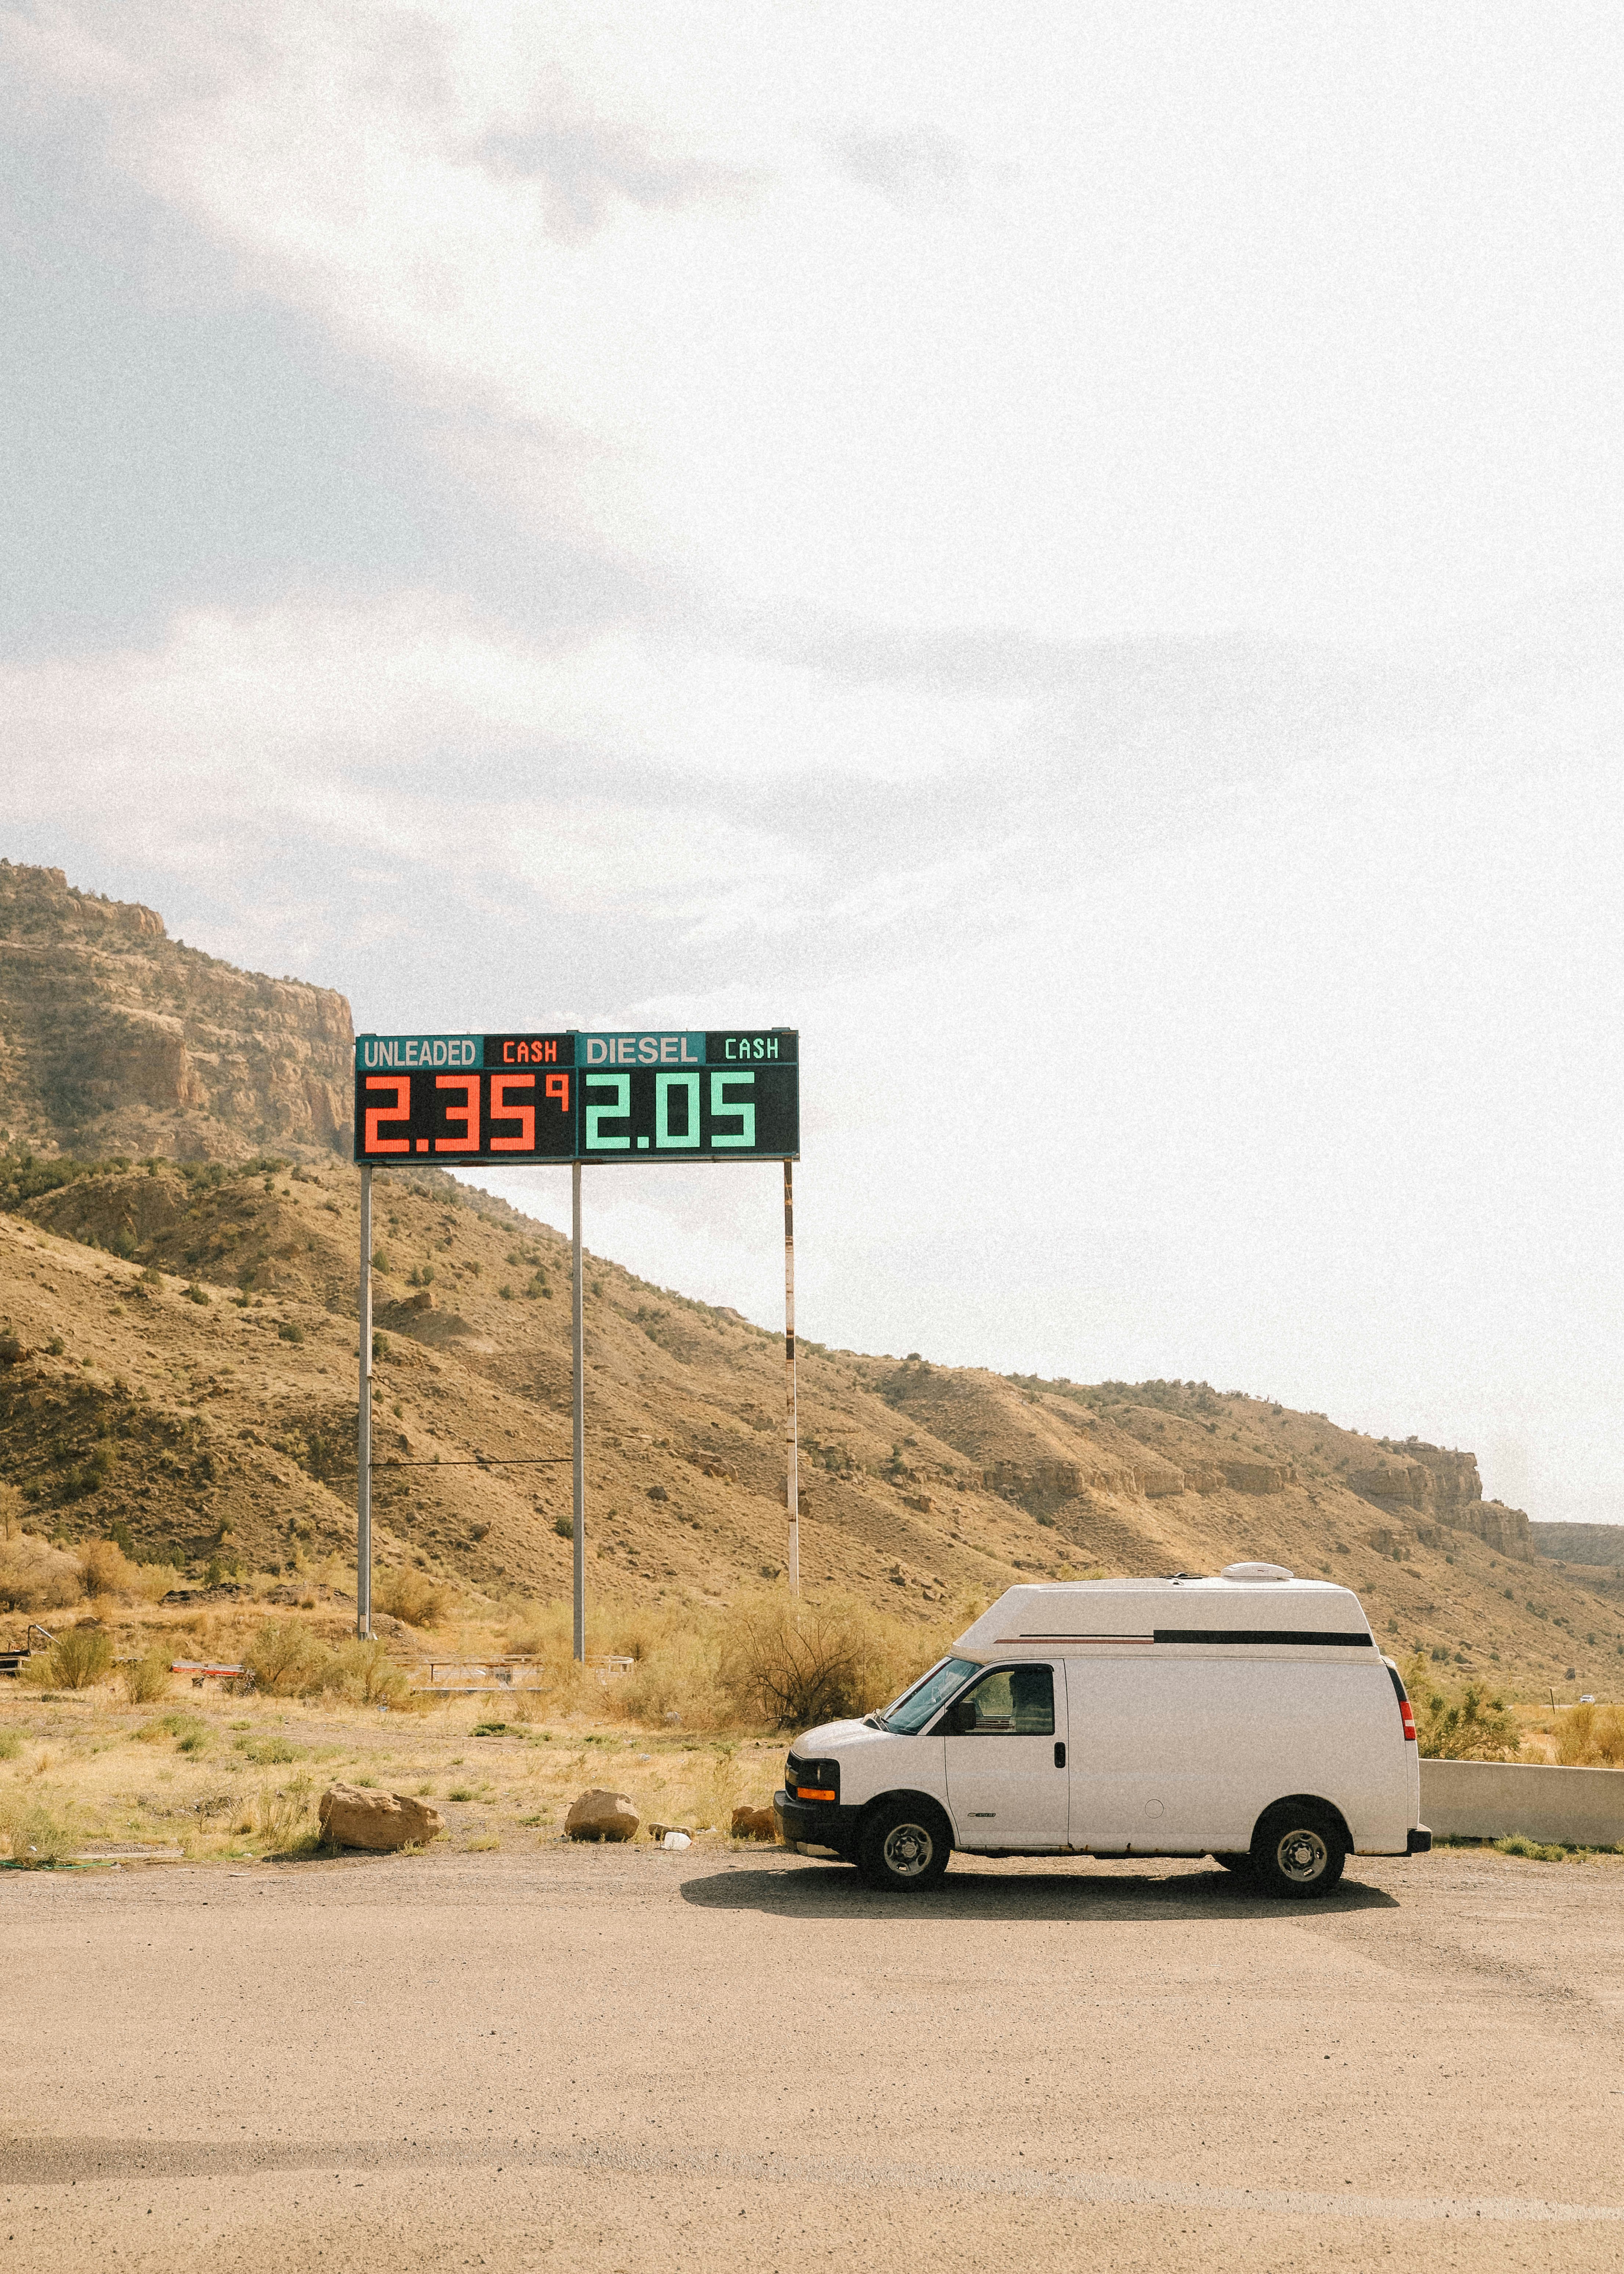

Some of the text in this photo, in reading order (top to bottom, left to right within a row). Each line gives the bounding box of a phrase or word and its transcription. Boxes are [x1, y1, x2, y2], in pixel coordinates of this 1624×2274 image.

[365, 1040, 557, 1067] UNLEADED CASH
[587, 1037, 778, 1064] DIESEL CASH
[586, 1071, 755, 1149] 2.05
